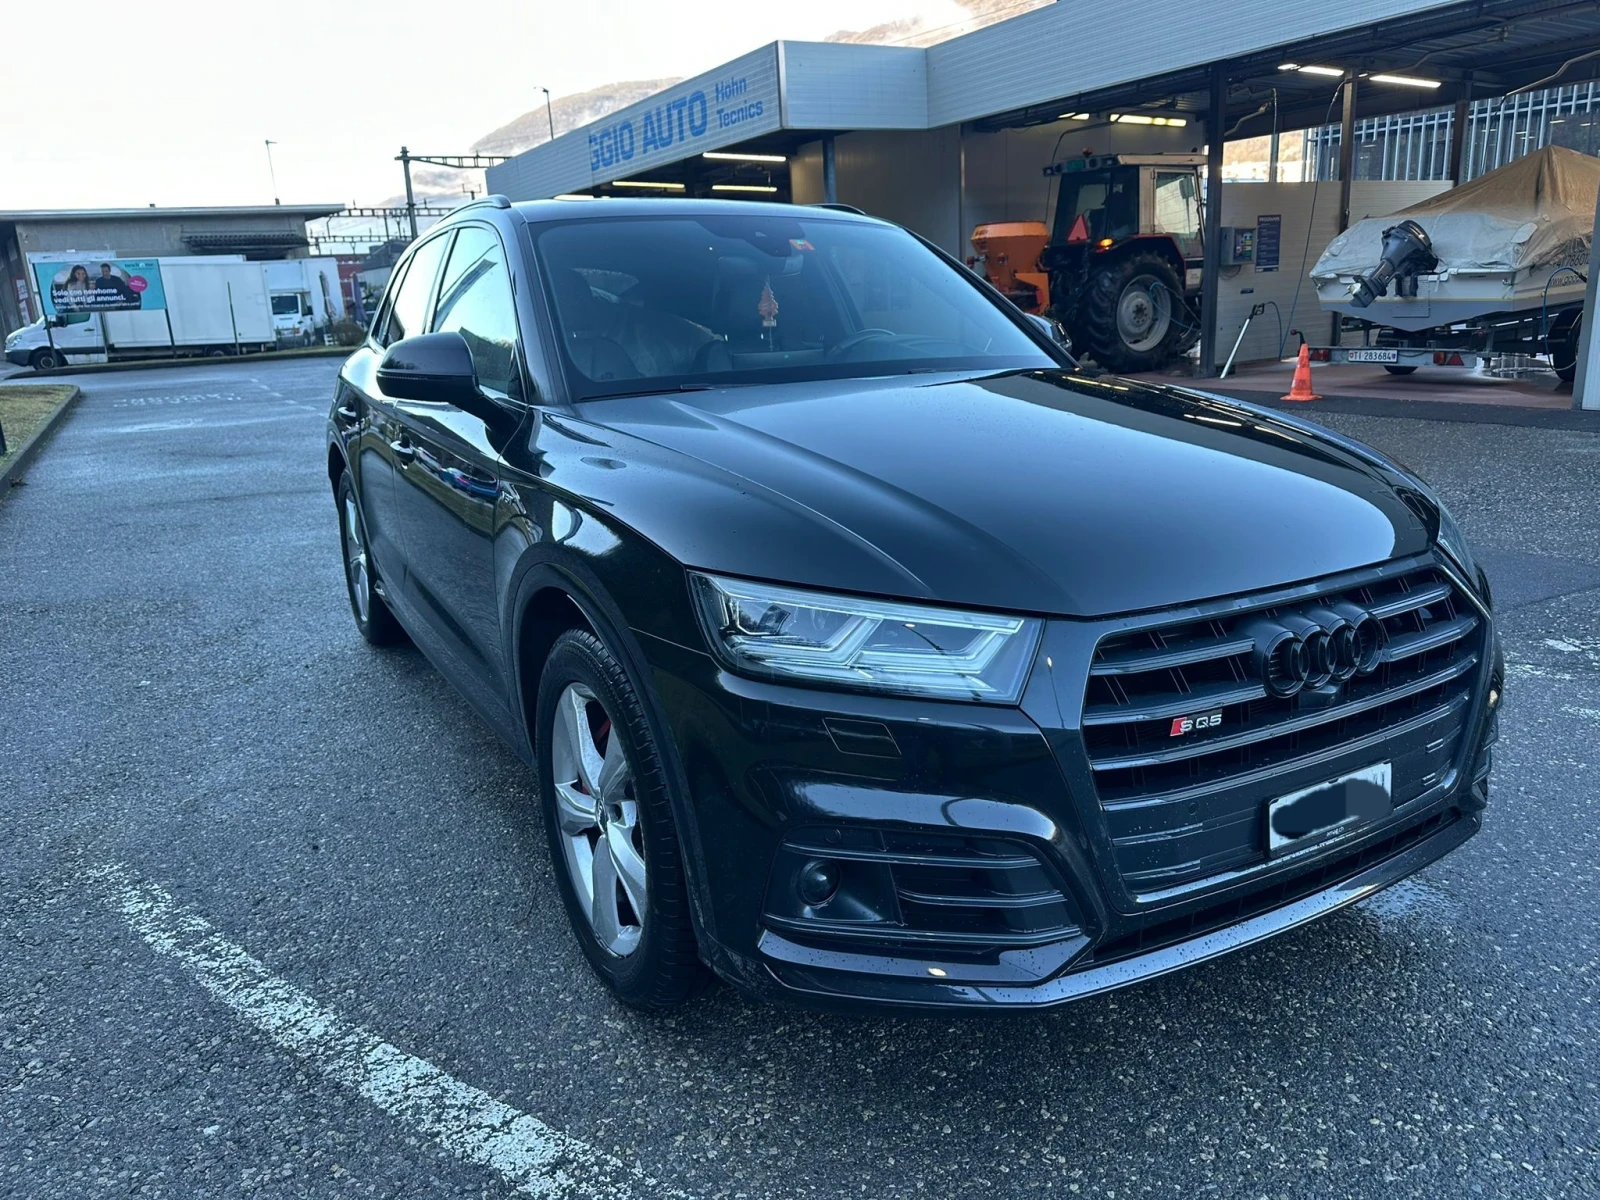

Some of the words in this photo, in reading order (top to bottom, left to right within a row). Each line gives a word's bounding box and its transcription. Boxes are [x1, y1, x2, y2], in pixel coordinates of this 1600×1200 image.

[716, 100, 763, 128] Tecnics
[642, 90, 708, 154] AUTO
[52, 289, 68, 297] Solo
[54, 296, 69, 304] vedi
[70, 295, 85, 303] tutti
[86, 295, 95, 303] gli
[1353, 351, 1362, 360] TI
[1364, 351, 1391, 360] 283684
[1180, 713, 1222, 733] SQ5
